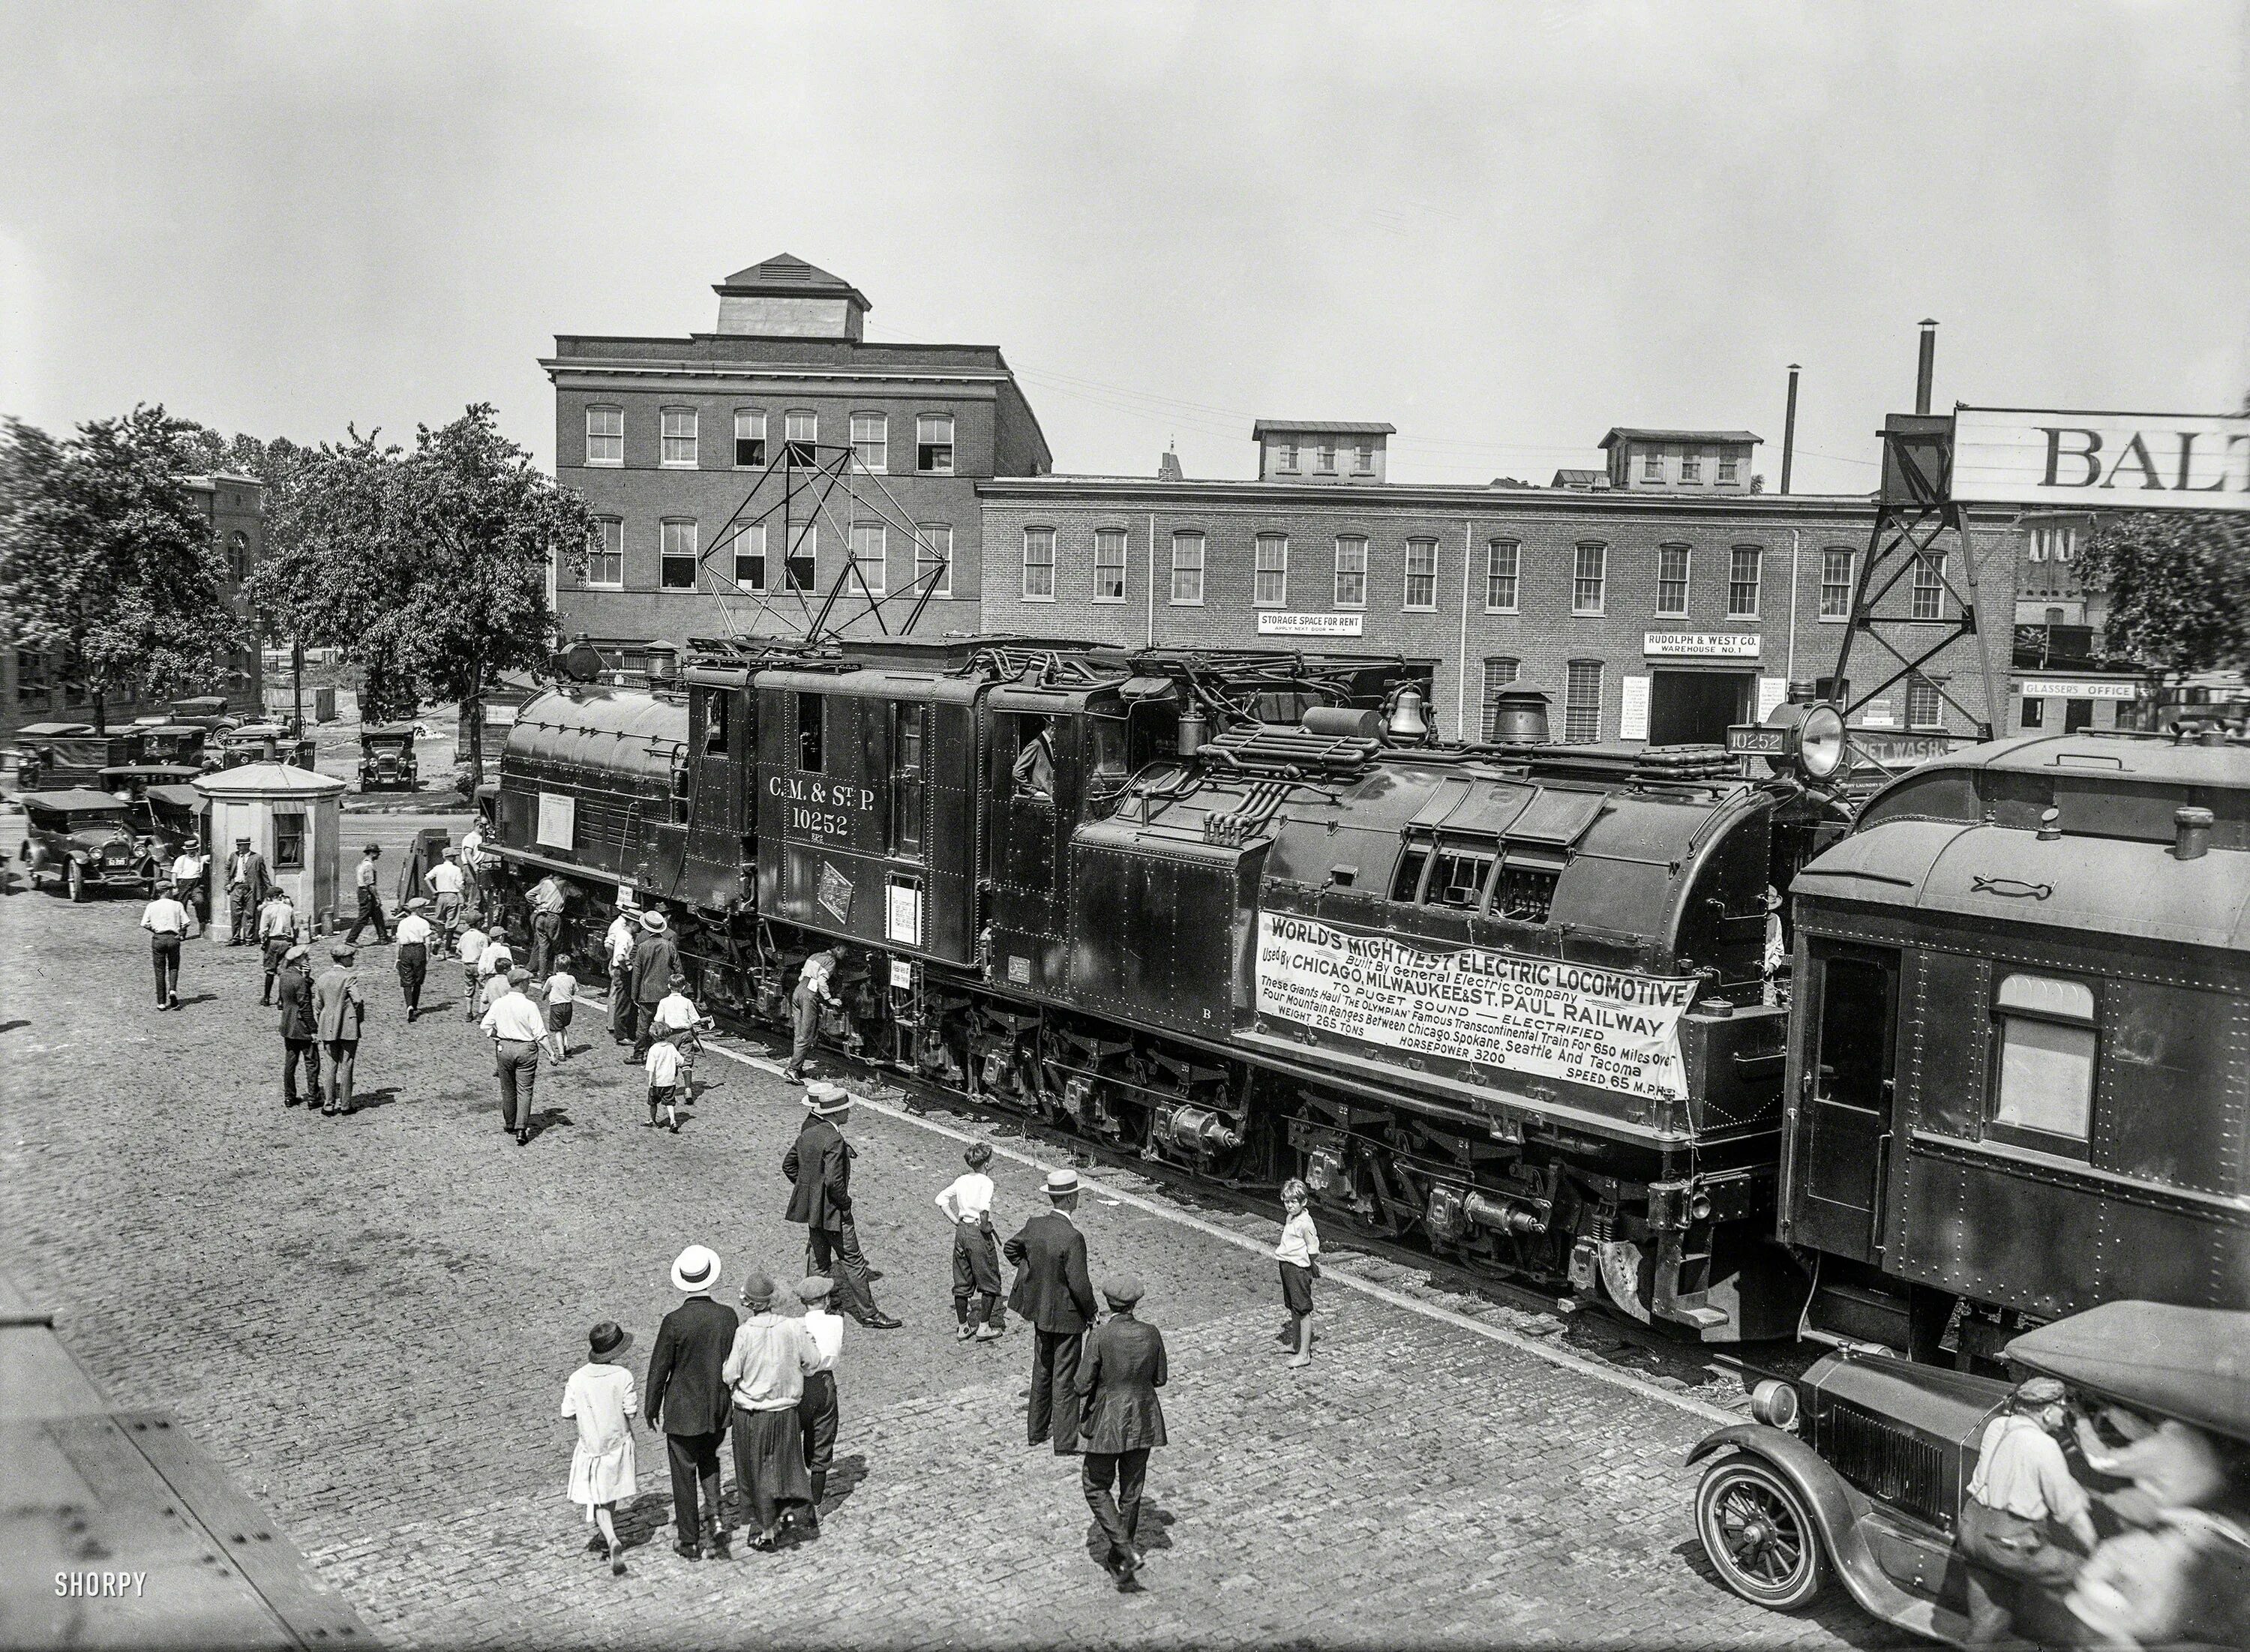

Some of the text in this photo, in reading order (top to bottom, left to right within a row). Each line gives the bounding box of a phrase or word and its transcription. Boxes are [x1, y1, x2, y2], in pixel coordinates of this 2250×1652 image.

[1262, 615, 1359, 627] STORAGE SPACE FOR RENT
[1648, 634, 1756, 646] RUDOLPH & WEST CO.
[1661, 645, 1716, 653] WAREHOUSE
[2088, 686, 2131, 696] OFFICE
[1732, 733, 1780, 749] 10252
[1893, 741, 1940, 759] WASH
[811, 782, 826, 803] &
[860, 789, 874, 811] P.
[793, 807, 848, 836] 10252
[1272, 917, 1688, 1007] WORLD'S MIGHTIEST ELECTRIC LOCOMOTIVE
[1346, 955, 1373, 970] Built
[1376, 961, 1390, 973] By
[1394, 965, 1450, 983] General
[1454, 973, 1510, 991] Electric
[1202, 1008, 1211, 1019] B
[1262, 975, 1288, 991] These
[1289, 983, 1318, 999] Giants
[1320, 989, 1341, 1004] Haul
[1412, 1011, 1453, 1027] Famous
[1455, 1018, 1538, 1042] Transcontinental
[1541, 1032, 1569, 1048] Train
[1571, 1039, 1592, 1051] For
[1594, 1043, 1616, 1057] 650
[1620, 1048, 1650, 1064] Miles
[1652, 1053, 1676, 1067] Over
[1278, 1005, 1365, 1036] WEIGHT 265 TONS
[1333, 982, 1350, 994] TO
[1355, 987, 1406, 1006] PUGET
[1413, 1000, 1469, 1017] SOUND
[1502, 1014, 1604, 1041] ELECTRIFIED
[1502, 993, 1555, 1018] PAUL
[1564, 1003, 1664, 1038] RAILWAY
[1263, 988, 1286, 1002] Four
[1286, 994, 1328, 1012] Mountain
[1330, 1005, 1364, 1023] Ranges
[1365, 1016, 1406, 1033] Between
[1505, 1039, 1552, 1060] Seattle
[1557, 1049, 1583, 1065] And
[1590, 1054, 1642, 1078] Tacoma
[1400, 1036, 1505, 1064] HORSEPOWER 3200
[1181, 1063, 1190, 1072] 20
[1566, 1067, 1606, 1084] SPEED
[1611, 1075, 1630, 1090] 65
[1339, 1105, 1348, 1115] 22
[1458, 1139, 1470, 1150] 24
[1605, 1178, 1618, 1189] 24
